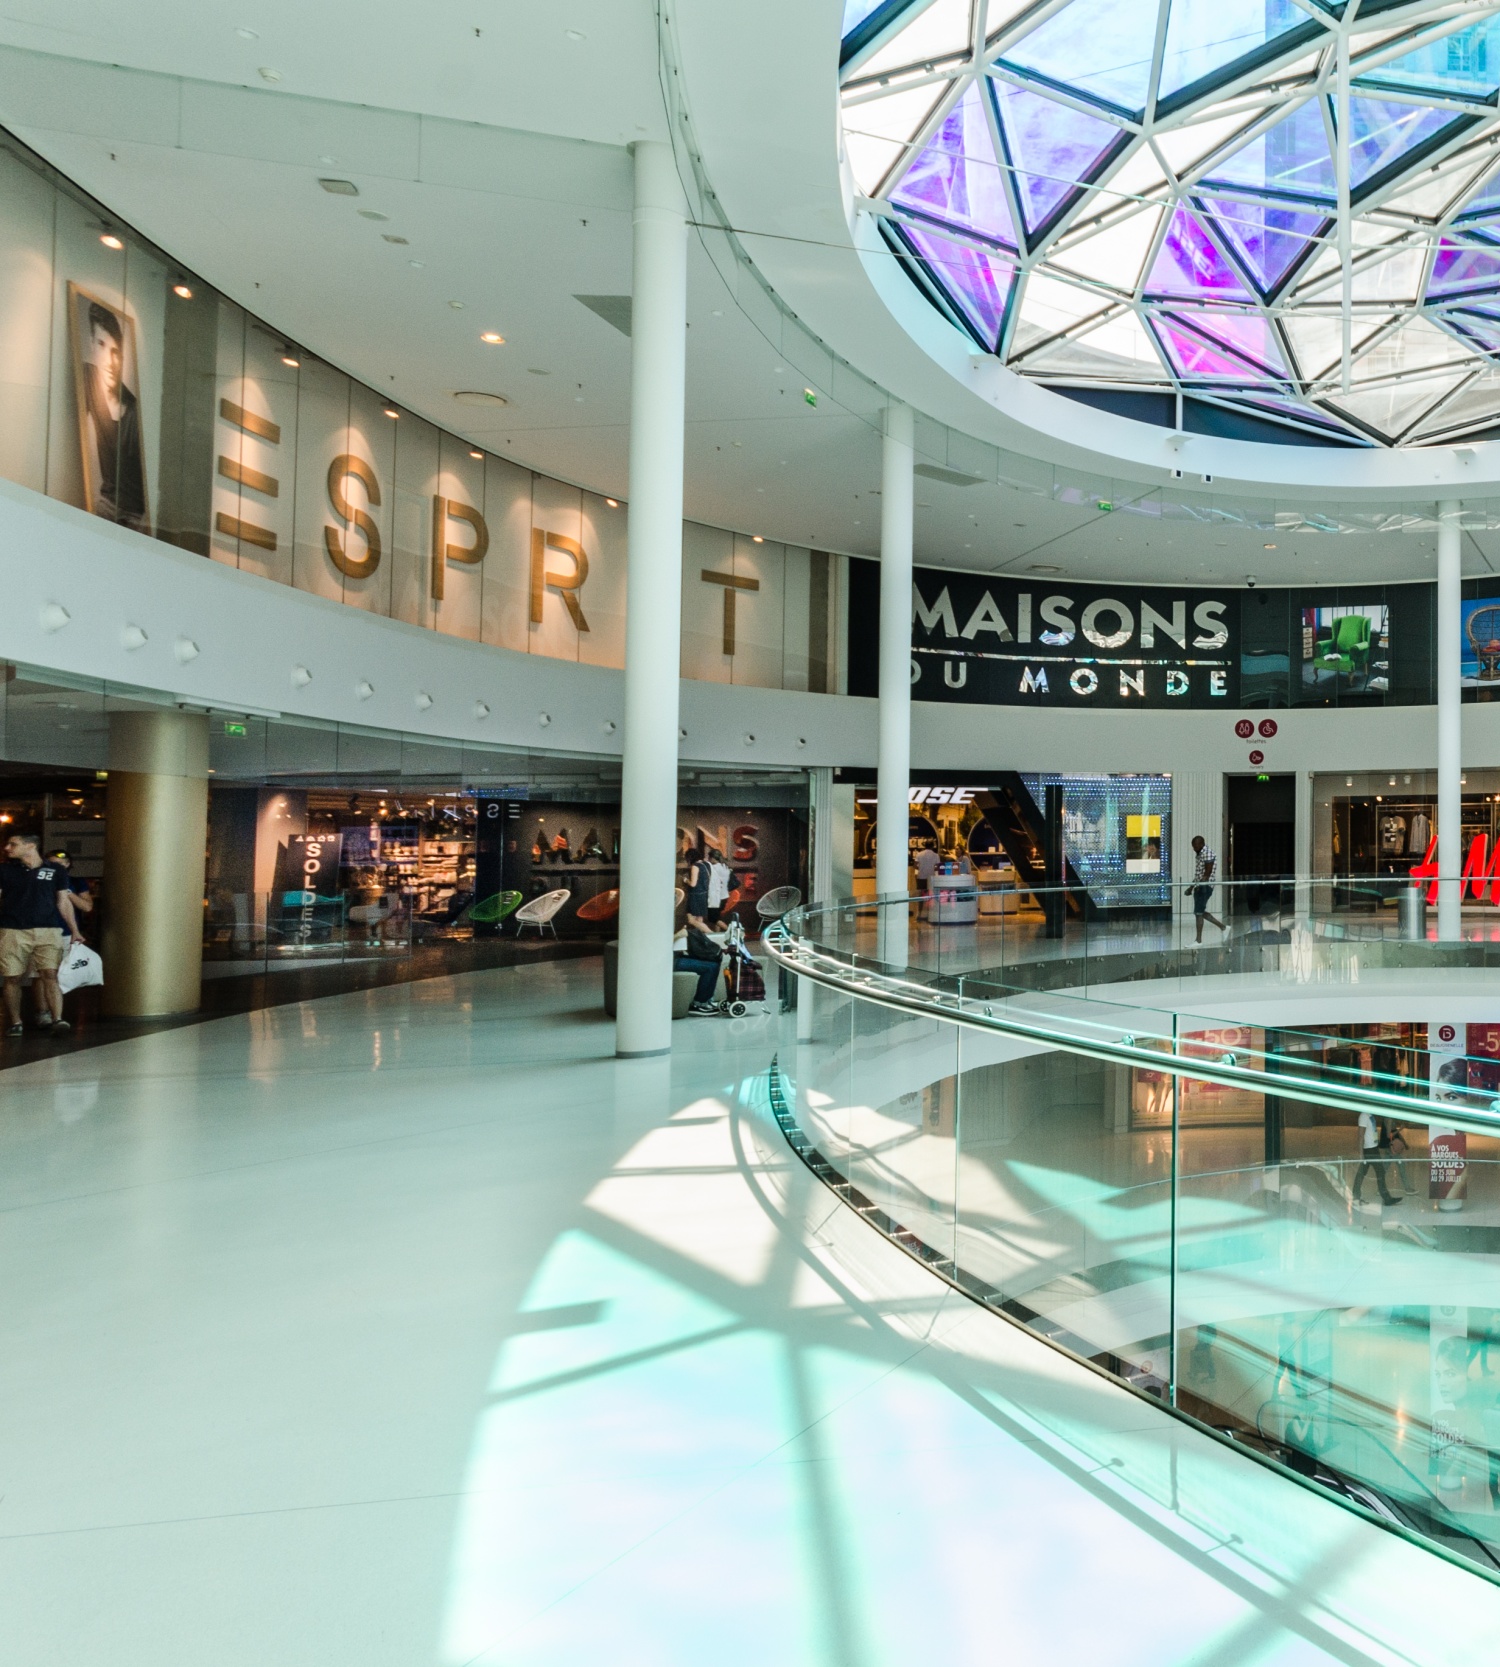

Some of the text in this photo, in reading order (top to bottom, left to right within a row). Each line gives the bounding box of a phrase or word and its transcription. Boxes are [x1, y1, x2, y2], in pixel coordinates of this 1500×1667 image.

[215, 397, 760, 656] ESPRT
[911, 580, 1229, 650] MAISONS
[1018, 666, 1228, 696] MONDE
[37, 871, 55, 881] 92
[302, 842, 321, 938] SOLDES
